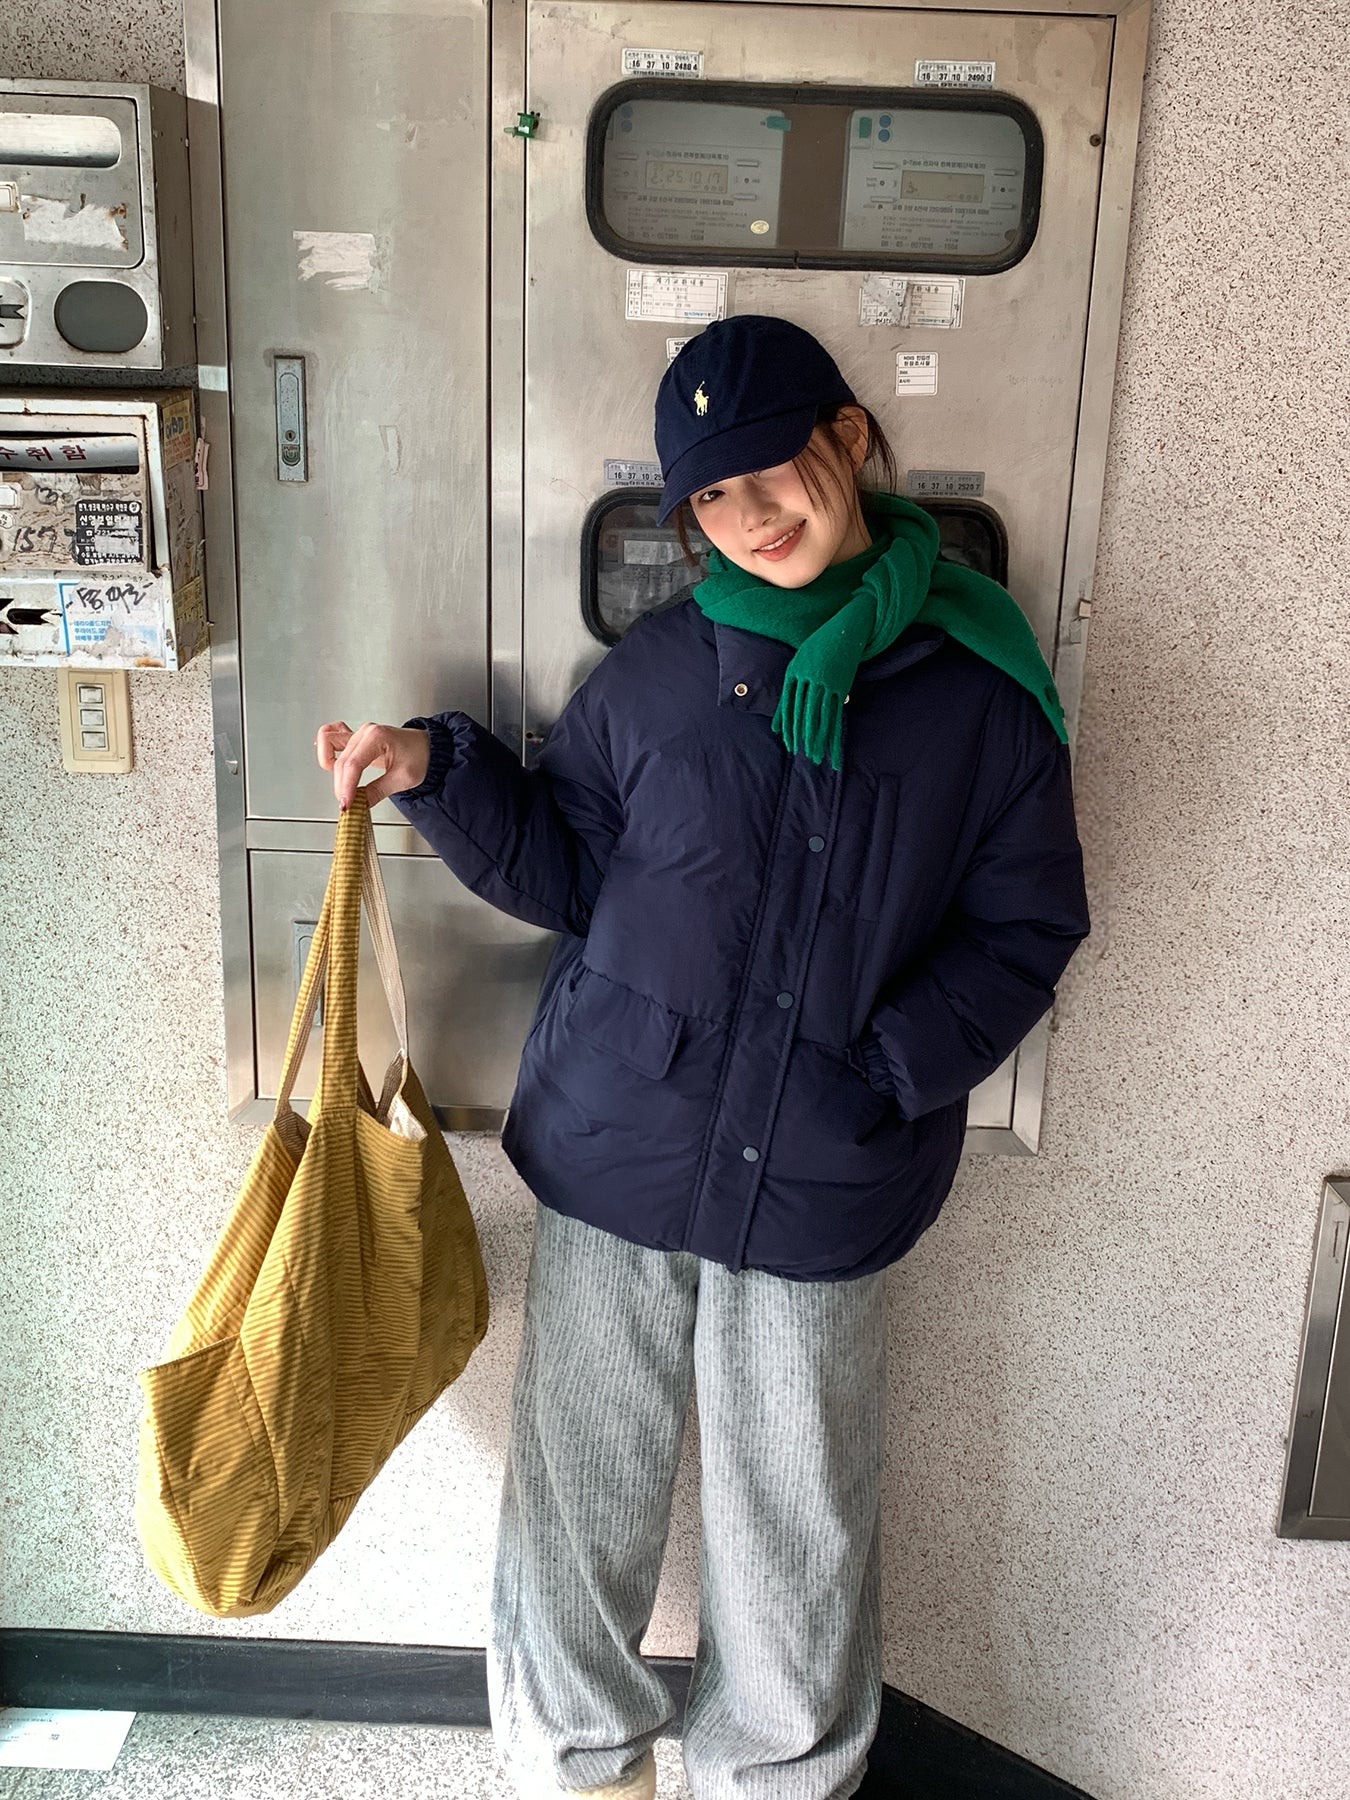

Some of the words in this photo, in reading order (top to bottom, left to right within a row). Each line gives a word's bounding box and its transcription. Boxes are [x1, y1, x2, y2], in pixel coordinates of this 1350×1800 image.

[646, 60, 656, 69] 37
[662, 61, 671, 70] 10
[952, 73, 961, 81] 10
[614, 471, 623, 479] 16
[627, 472, 637, 480] 37
[642, 473, 650, 481] 10
[931, 482, 940, 490] 37
